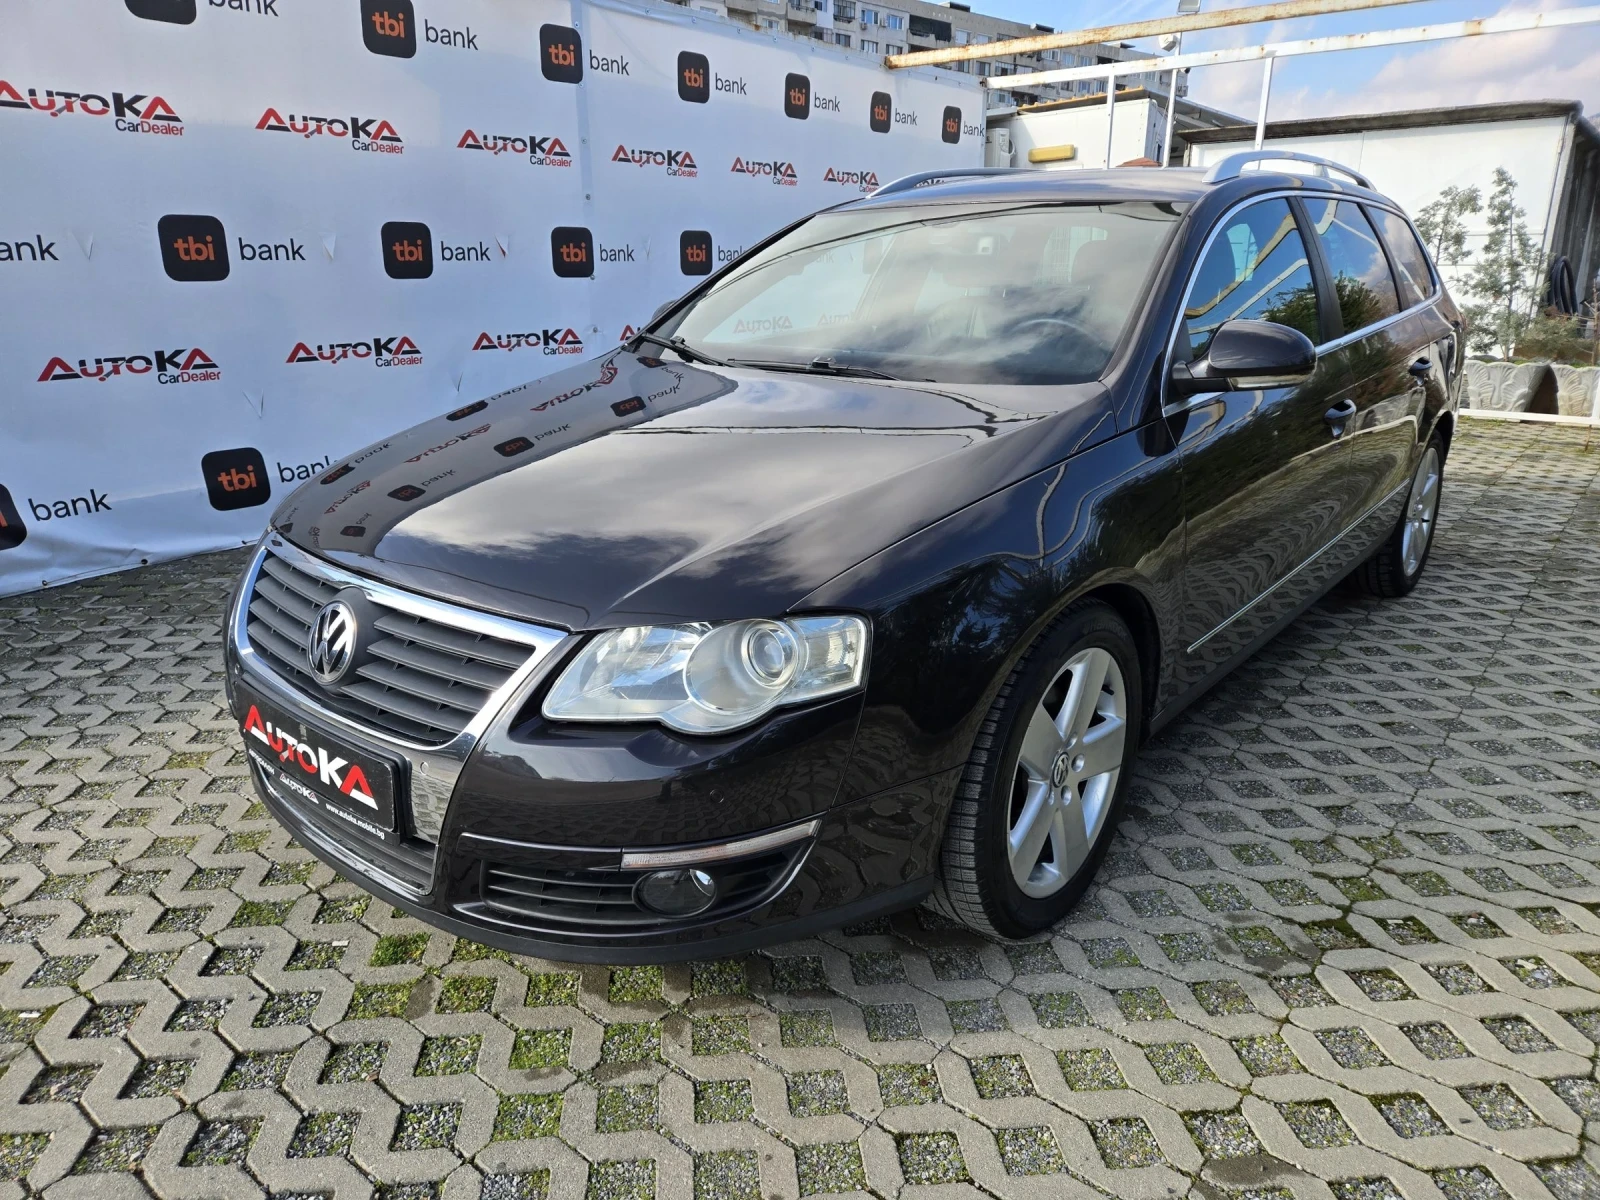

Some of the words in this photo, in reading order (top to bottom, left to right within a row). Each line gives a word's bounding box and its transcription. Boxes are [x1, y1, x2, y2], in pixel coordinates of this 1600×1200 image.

[209, 0, 279, 17] ank
[372, 11, 405, 38] tbi
[424, 19, 479, 50] bank
[549, 43, 575, 67] tbi
[589, 49, 630, 76] bank
[684, 68, 704, 88] tbi
[715, 72, 747, 95] bank
[789, 88, 806, 106] tbi
[814, 92, 841, 112] bank
[874, 105, 888, 121] tbi
[894, 108, 918, 126] bank
[115, 118, 184, 136] CarDealer
[946, 118, 958, 133] tbi
[963, 121, 985, 137] bank
[351, 139, 405, 155] CarDealer
[529, 155, 573, 167] CarDealer
[666, 167, 698, 178] CarDealer
[0, 234, 59, 262] ank
[174, 235, 215, 261] tbi
[239, 236, 305, 262] bank
[393, 239, 423, 262] tbi
[440, 241, 491, 263] bank
[560, 242, 586, 262] tbi
[600, 244, 635, 262] bank
[686, 244, 706, 262] tbi
[543, 345, 584, 356] CarDealer
[375, 355, 423, 367] CarDealer
[157, 370, 221, 385] CarDealer
[217, 464, 257, 492] tbi
[28, 488, 112, 522] bank
